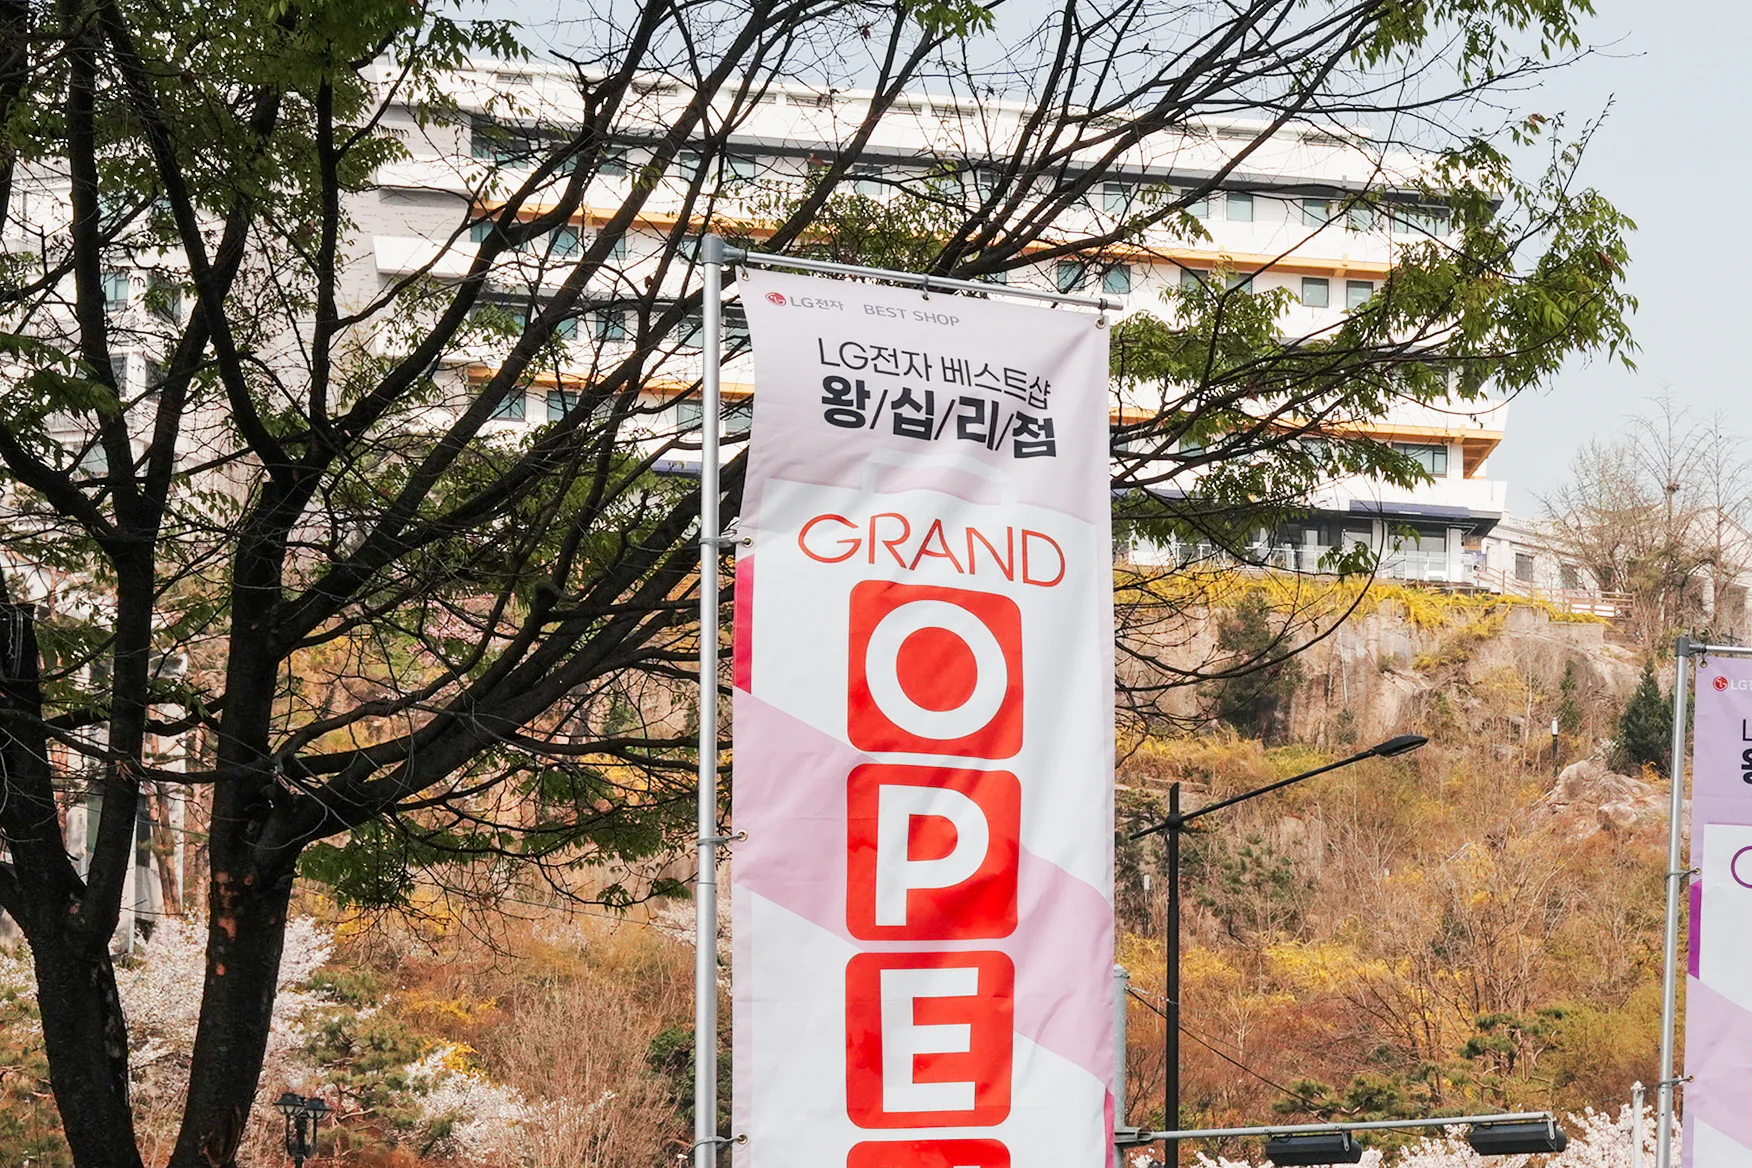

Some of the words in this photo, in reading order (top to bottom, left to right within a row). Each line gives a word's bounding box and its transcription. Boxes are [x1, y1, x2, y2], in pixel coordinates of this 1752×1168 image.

[790, 296, 844, 312] LG전자
[863, 304, 907, 320] BEST
[914, 310, 960, 327] SHOP
[818, 338, 932, 382] LG전자
[942, 355, 1051, 410] 베스트샵
[821, 375, 1057, 459] 왕/십/리/점
[798, 512, 1066, 588] GRAND
